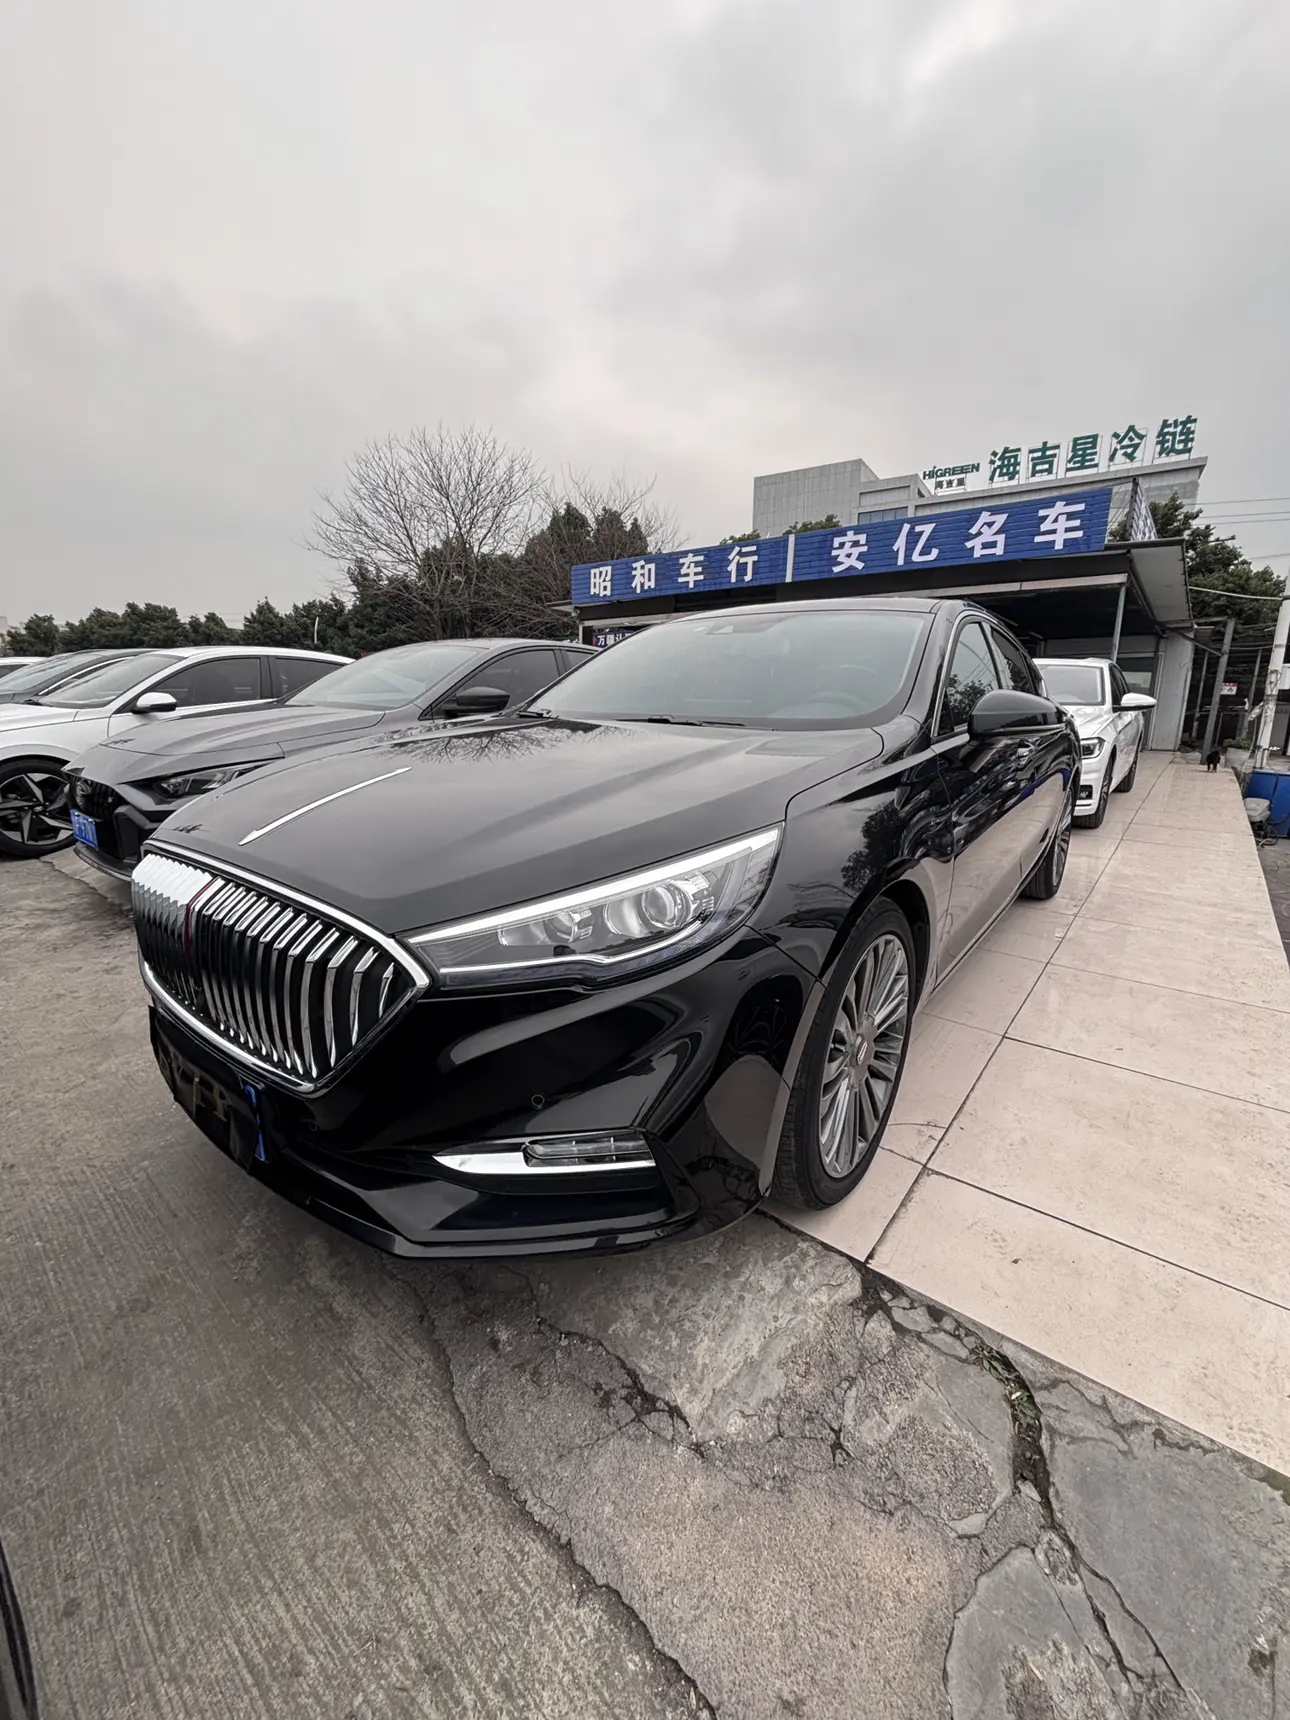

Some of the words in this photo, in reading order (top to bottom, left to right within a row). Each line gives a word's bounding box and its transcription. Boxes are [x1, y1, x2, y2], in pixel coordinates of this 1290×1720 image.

[988, 415, 1198, 481] 海吉星冷链
[590, 546, 758, 597] 昭和车行
[831, 501, 1086, 573] 安亿名车
